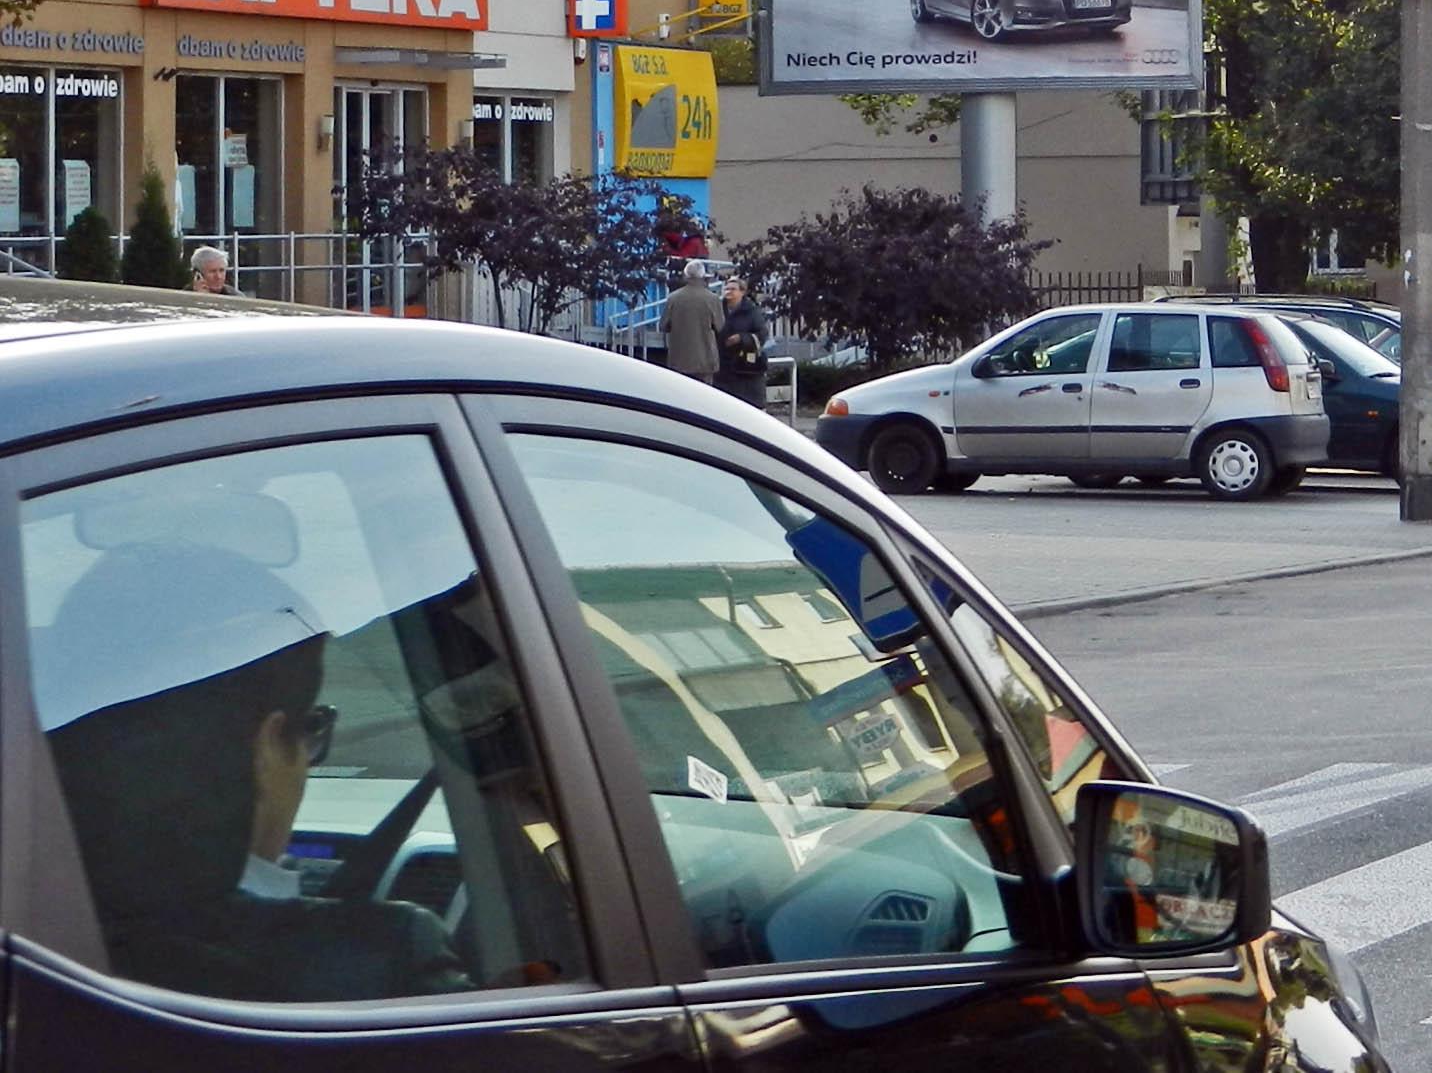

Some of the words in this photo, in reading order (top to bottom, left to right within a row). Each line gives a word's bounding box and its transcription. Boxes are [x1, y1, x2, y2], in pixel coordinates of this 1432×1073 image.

[1, 24, 52, 49] dbam
[56, 31, 69, 51] o
[72, 29, 145, 54] zdrowie
[177, 34, 222, 59] dbam
[227, 39, 238, 59] o
[241, 39, 305, 63] zdrowie
[786, 53, 841, 67] Niech
[846, 51, 876, 68] Cię
[881, 50, 977, 68] prowadzi!
[34, 76, 45, 94] o
[56, 74, 118, 97] zdrowie
[473, 103, 492, 119] am
[495, 104, 503, 119] o
[511, 102, 553, 121] zdrowie
[681, 95, 712, 140] 24h
